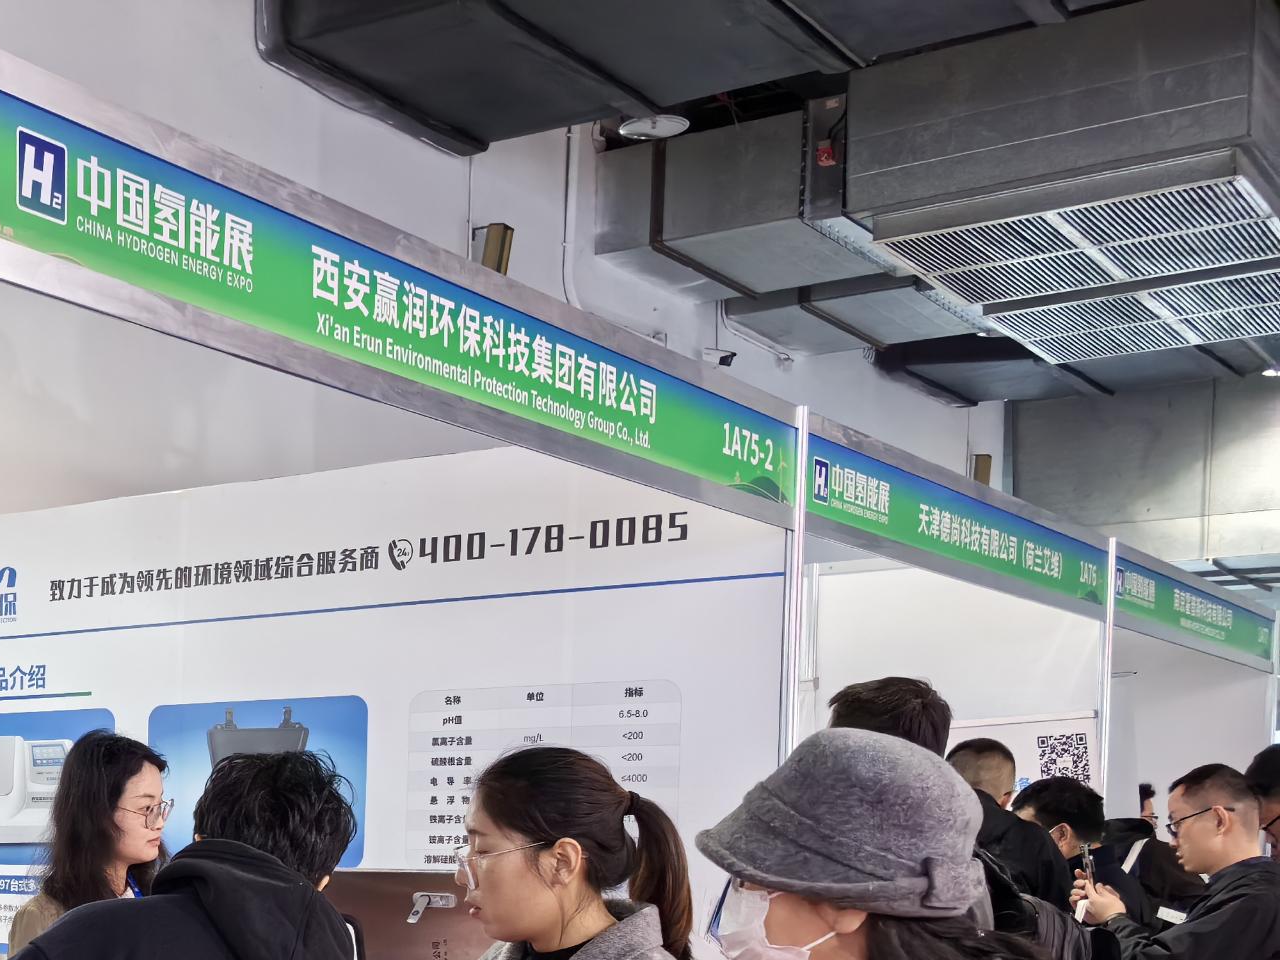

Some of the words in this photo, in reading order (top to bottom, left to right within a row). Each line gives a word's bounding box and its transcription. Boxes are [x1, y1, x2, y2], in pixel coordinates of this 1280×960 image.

[76, 155, 253, 275] 中国氢能展
[76, 215, 113, 243] CHINA
[117, 230, 179, 267] HYDROGEN
[182, 254, 224, 283] ENERGY
[226, 271, 253, 293] EXPO
[311, 244, 657, 425] 西安赢润环保科技集团有限公司
[316, 312, 350, 344] Xi'an
[353, 325, 383, 355] Erun
[386, 337, 472, 386] Environmental
[474, 368, 528, 406] Protection
[530, 389, 587, 430] Technology
[587, 410, 615, 439] Group
[616, 421, 634, 447] Co.,
[635, 426, 651, 449] Ltd.
[722, 422, 774, 473] 1A75-2
[831, 463, 890, 514] 中国氢能展
[419, 510, 690, 565] 400-178-0085
[49, 545, 380, 602] 致力于成为领先的环境领域综合服务商
[442, 715, 462, 726] pH值
[444, 695, 462, 706] 名称
[526, 691, 544, 702] 单位
[624, 687, 644, 698] 指标
[618, 709, 649, 719] 6.5-8.0
[523, 733, 544, 743] mg/L
[621, 752, 643, 762] <200
[622, 731, 644, 741] <200
[431, 757, 472, 767] 硫酸根含量
